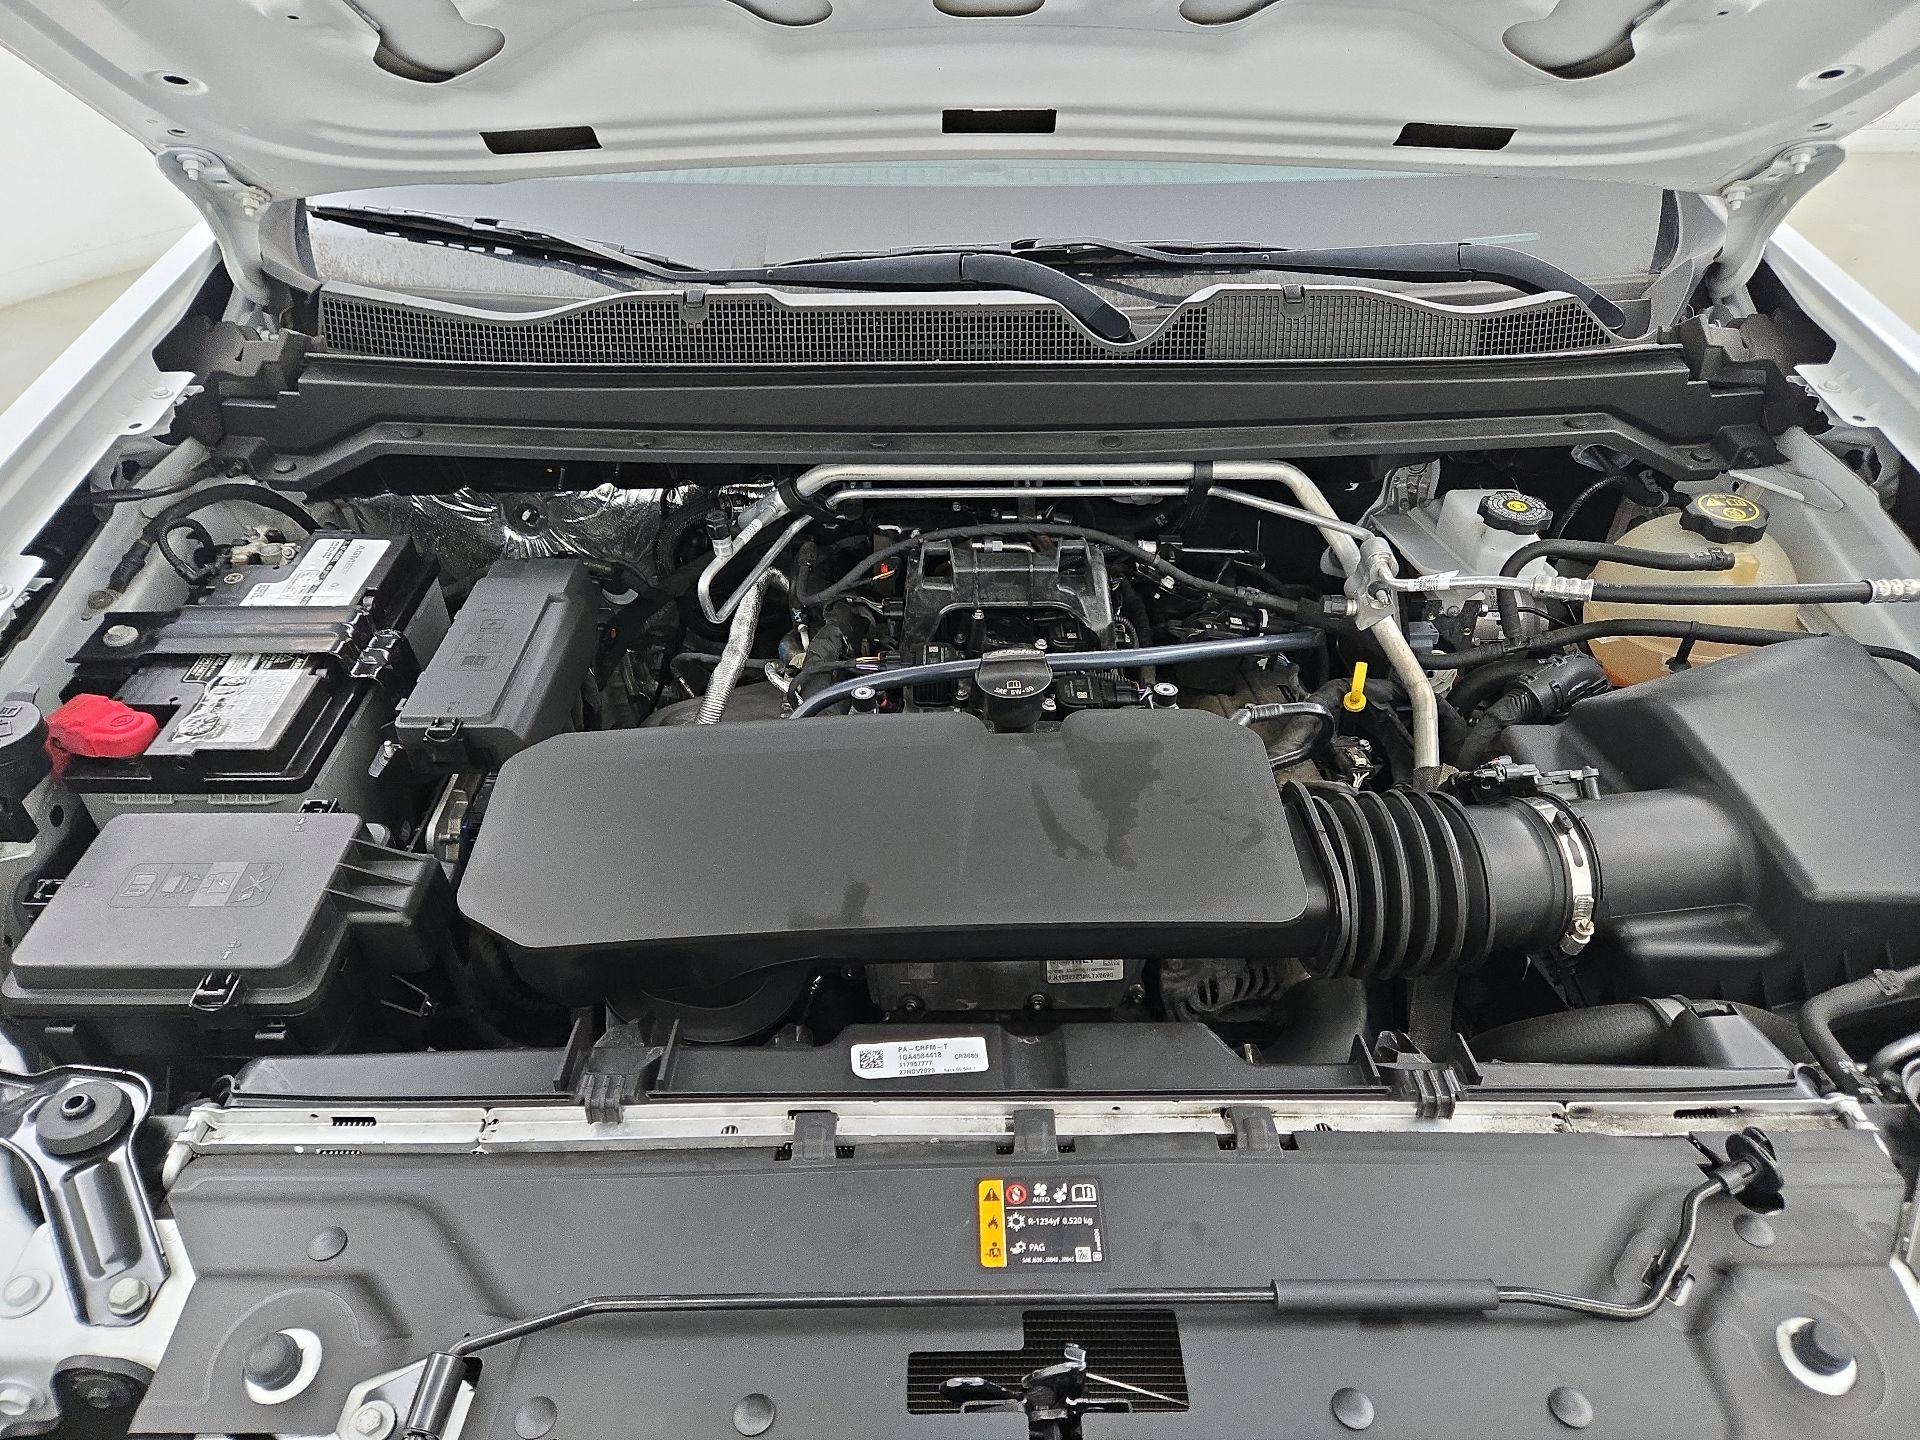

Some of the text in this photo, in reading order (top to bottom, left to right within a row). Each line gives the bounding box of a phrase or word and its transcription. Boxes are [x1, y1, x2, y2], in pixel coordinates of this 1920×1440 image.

[994, 685, 1035, 695] SAE 5W-30
[899, 1067, 936, 1075] 27NOV2023
[1027, 1216, 1094, 1227] R-1234yf 0.520 kg
[1029, 1243, 1046, 1252] PAG
